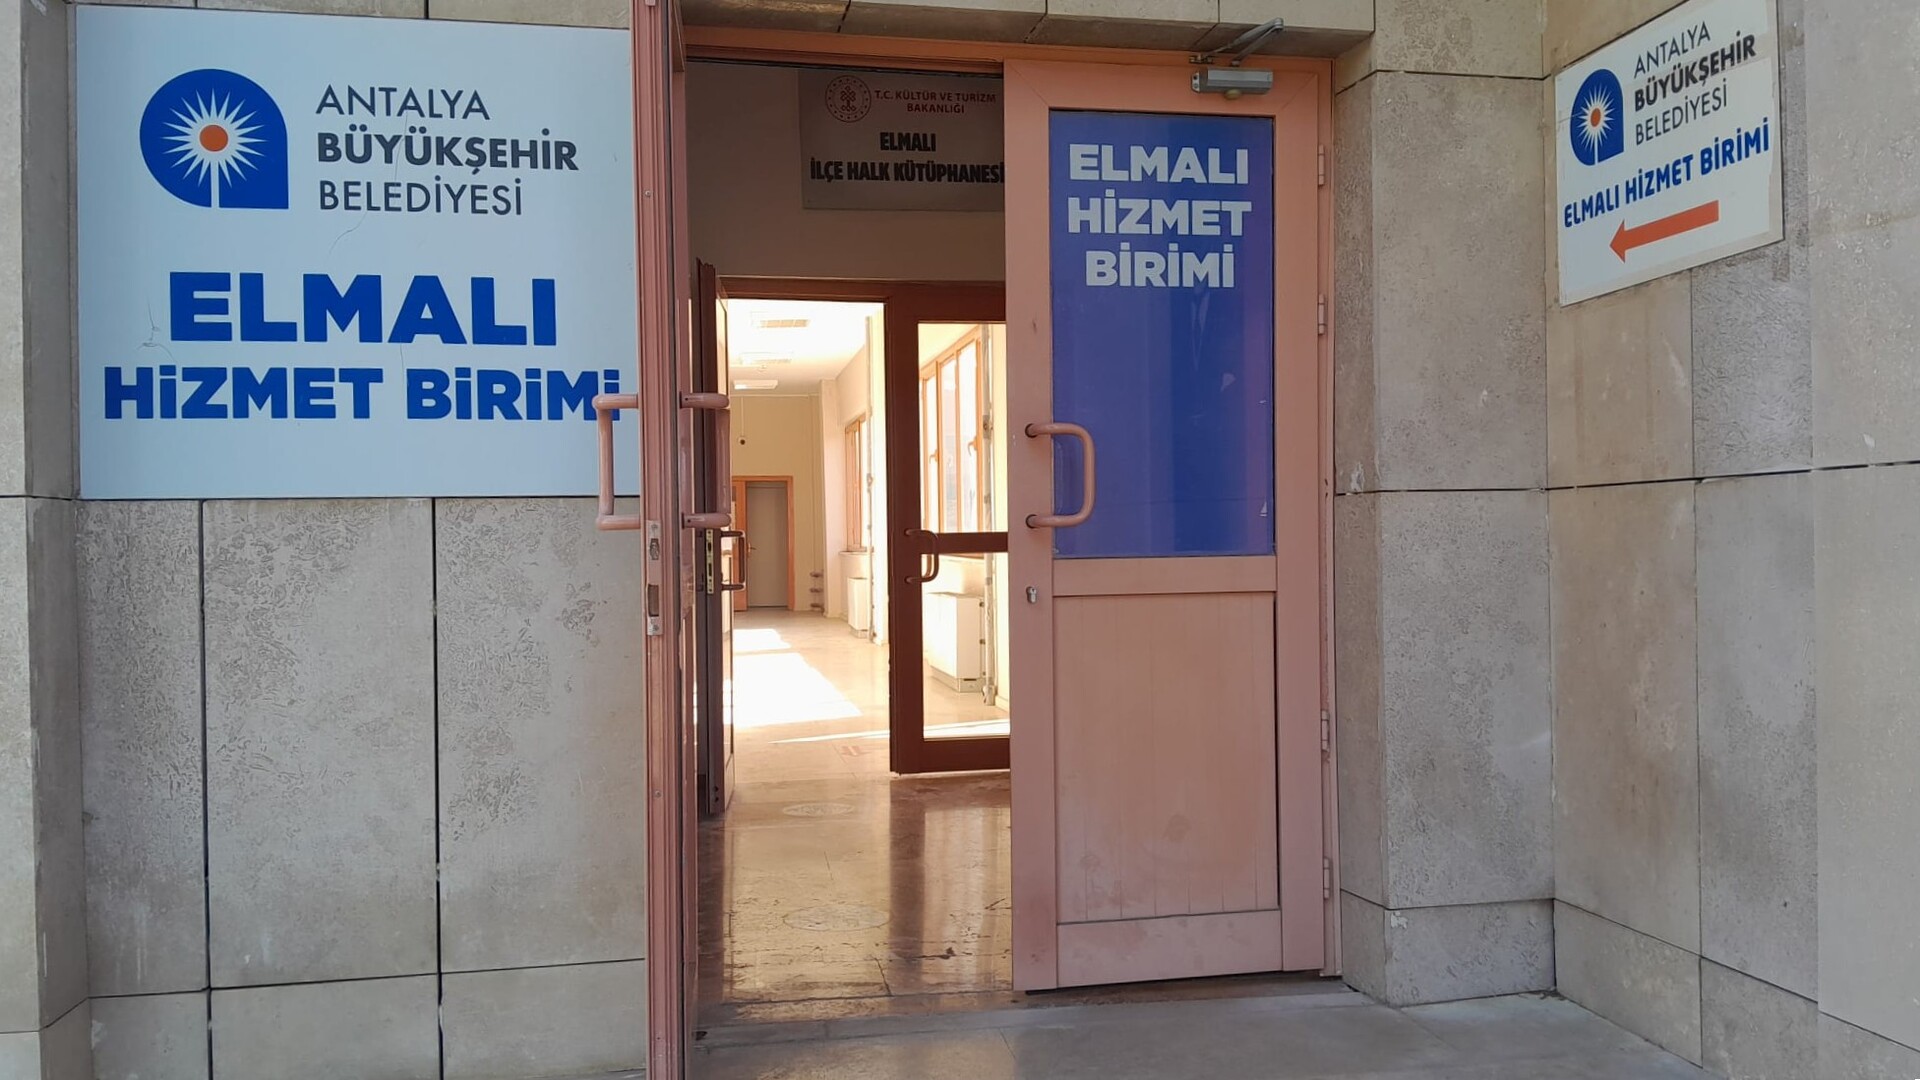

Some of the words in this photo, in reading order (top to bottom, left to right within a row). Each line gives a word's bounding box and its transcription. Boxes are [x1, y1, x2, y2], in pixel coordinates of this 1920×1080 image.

[1634, 21, 1711, 79] ANTALYA
[1634, 30, 1757, 112] BÜYÜKŞEHİR
[316, 84, 490, 121] ANTALYA
[875, 90, 893, 100] T.C.
[895, 89, 937, 102] KÜLTÜR
[941, 92, 953, 102] VE
[956, 92, 997, 104] TURİZM
[907, 102, 965, 114] BAKANLIĞI
[1635, 78, 1728, 146] BELEDİYESİ
[317, 123, 580, 176] BÜYÜKŞEHİR
[880, 132, 937, 152] ELMALI
[1069, 143, 1249, 184] ELMALI
[810, 157, 844, 183] İLÇE
[847, 161, 891, 181] HALK
[894, 160, 1004, 184] KÜTÜPHANESİ
[1564, 184, 1620, 229] ELMALI
[1624, 154, 1694, 205] HİZMET
[1700, 117, 1770, 176] BİRİMİ
[319, 176, 523, 216] BELEDİYESİ
[1067, 188, 1252, 236] HİZMET
[1085, 242, 1235, 288] BİRİMİ
[169, 271, 557, 346] ELMALI
[104, 365, 384, 420] HİZMET
[406, 367, 620, 421] BİRİMİ
